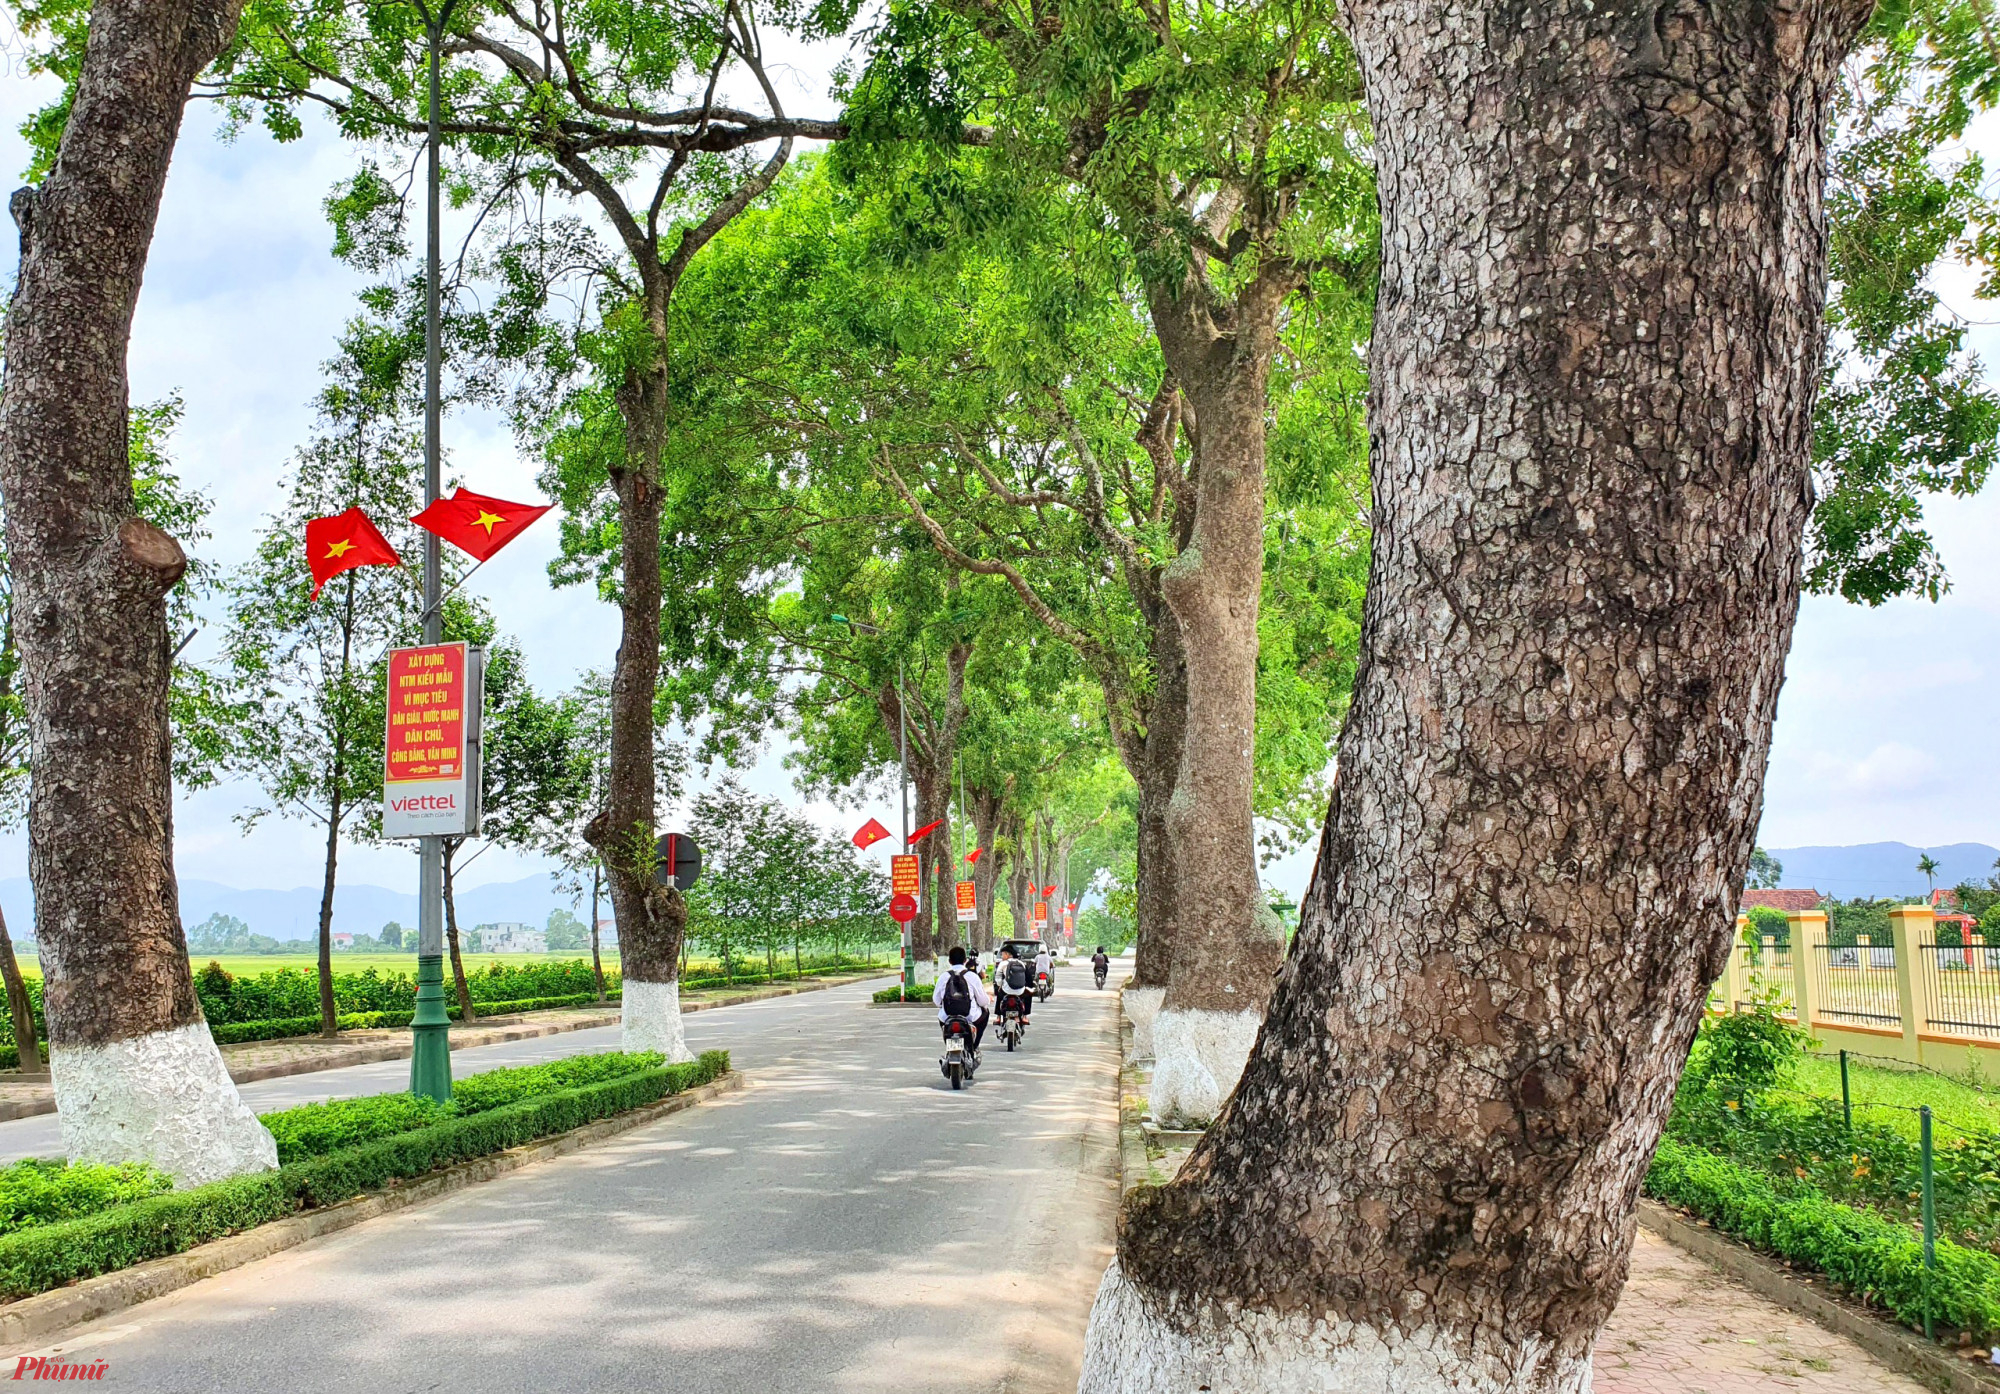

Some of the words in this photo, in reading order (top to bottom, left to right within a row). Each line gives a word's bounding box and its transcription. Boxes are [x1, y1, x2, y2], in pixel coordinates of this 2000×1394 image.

[408, 653, 423, 668] XÂY
[424, 653, 445, 669] DỰNG
[399, 674, 416, 688] NTM
[435, 667, 453, 684] MẪU
[404, 691, 412, 706] VÌ
[412, 692, 430, 707] MỤC
[432, 689, 448, 704] TIÊU
[392, 711, 406, 726] DÂN
[422, 707, 440, 723] NƯỚC
[440, 708, 460, 724] MẠNH
[405, 728, 423, 743] DÂN
[424, 724, 445, 742] CHỦ,
[391, 748, 408, 763] CÔNG
[440, 746, 457, 760] MINH
[391, 794, 456, 812] viettel
[420, 811, 435, 819] cách
